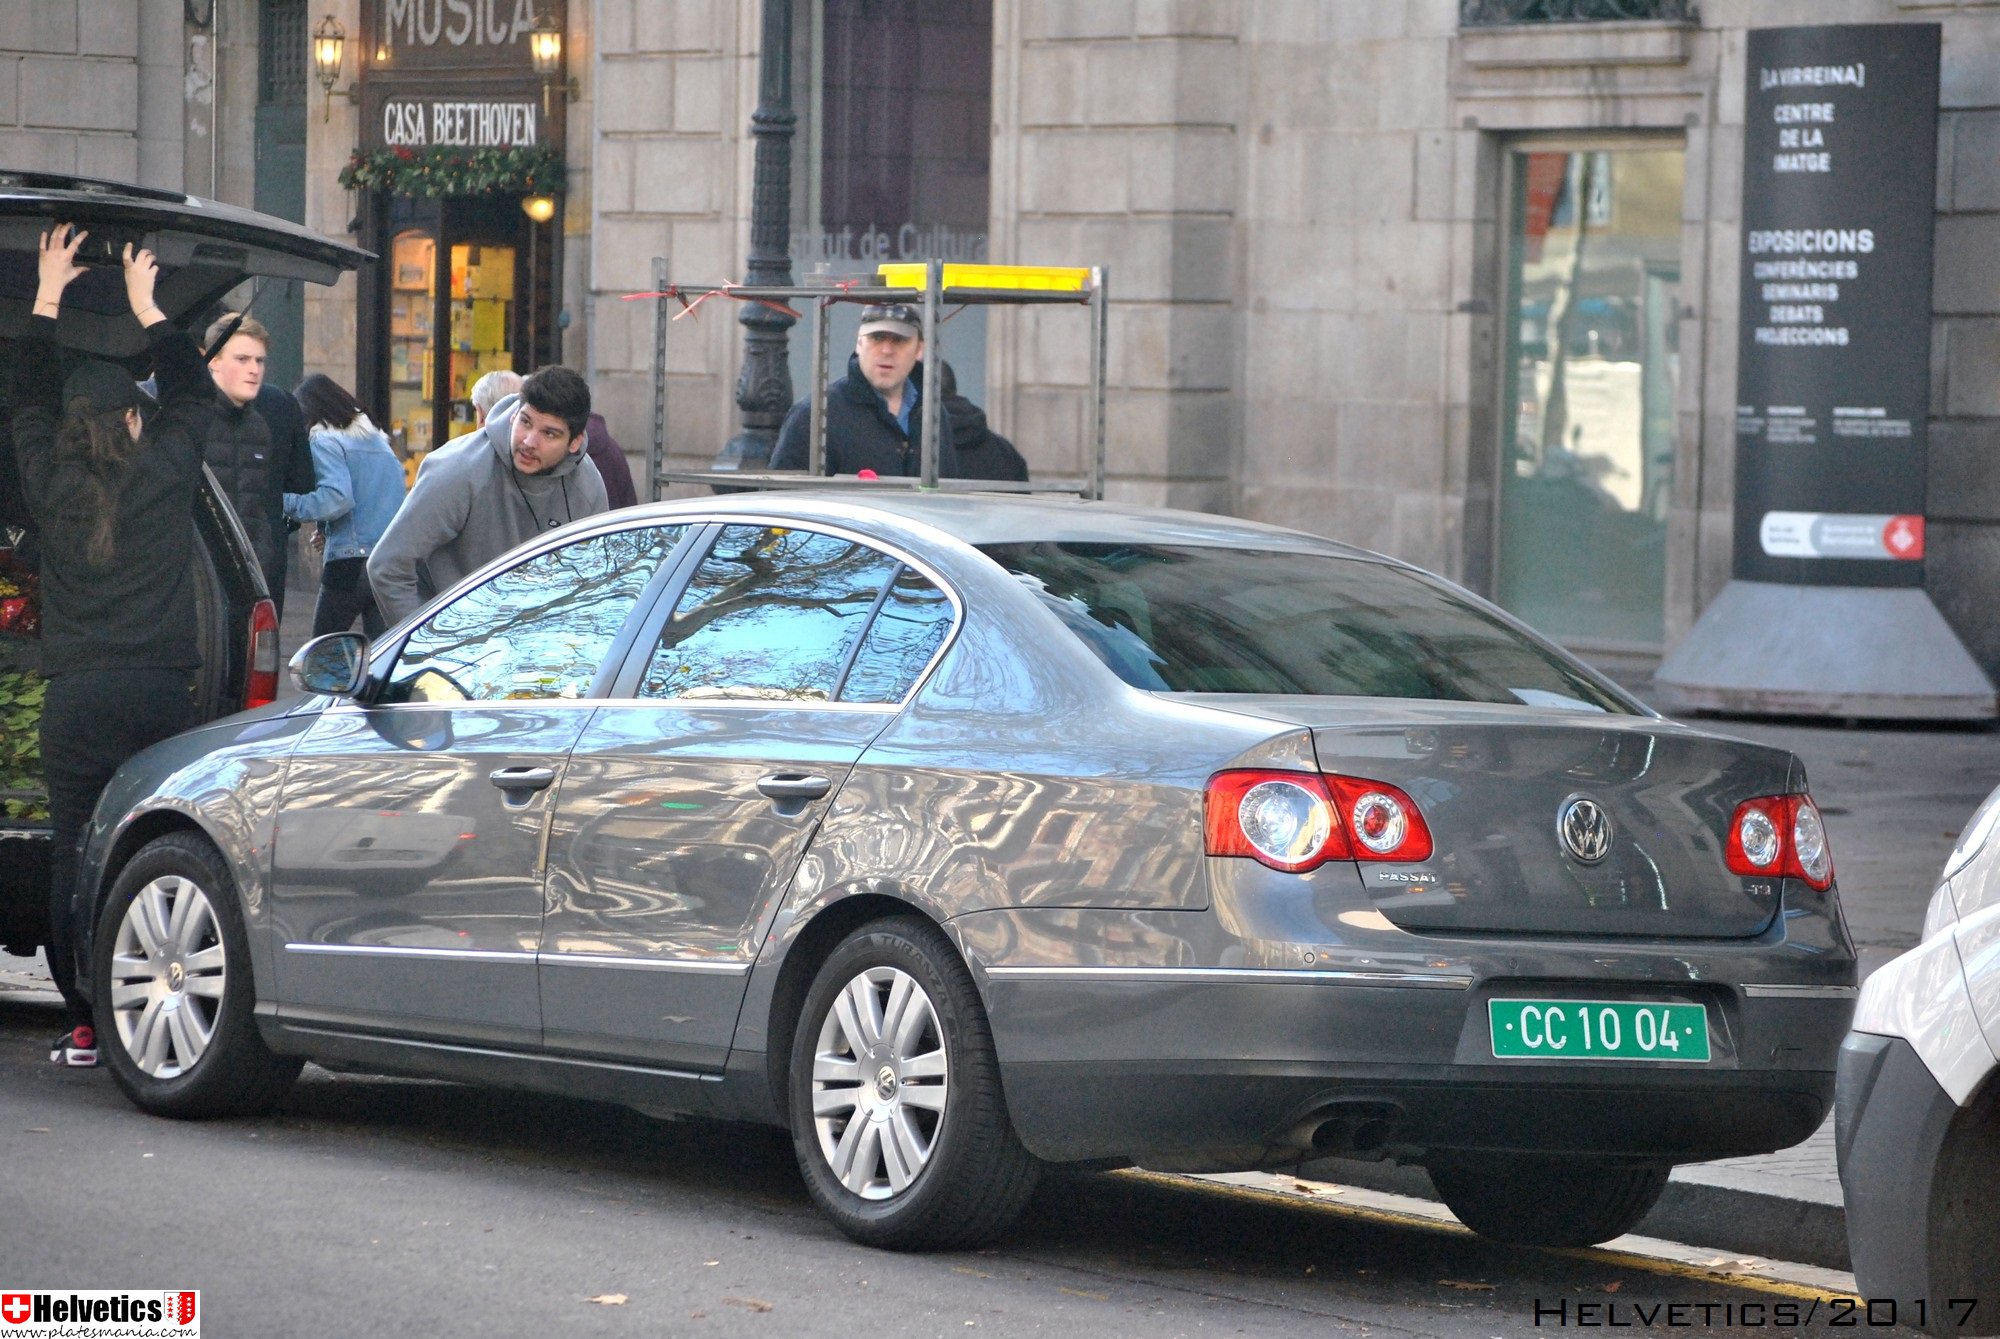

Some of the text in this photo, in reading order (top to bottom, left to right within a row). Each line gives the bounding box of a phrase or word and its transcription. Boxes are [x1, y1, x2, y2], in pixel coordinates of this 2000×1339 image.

[384, 102, 537, 146] CASA BEETHOVEN
[1774, 103, 1835, 124] CENTRE
[1780, 128, 1824, 148] DE LA
[789, 223, 852, 260] stitut
[860, 222, 890, 261] de
[1748, 229, 1874, 253] EXPOSICIONS
[1379, 871, 1438, 883] PASSAT
[1520, 1005, 1679, 1052] CC 10 04
